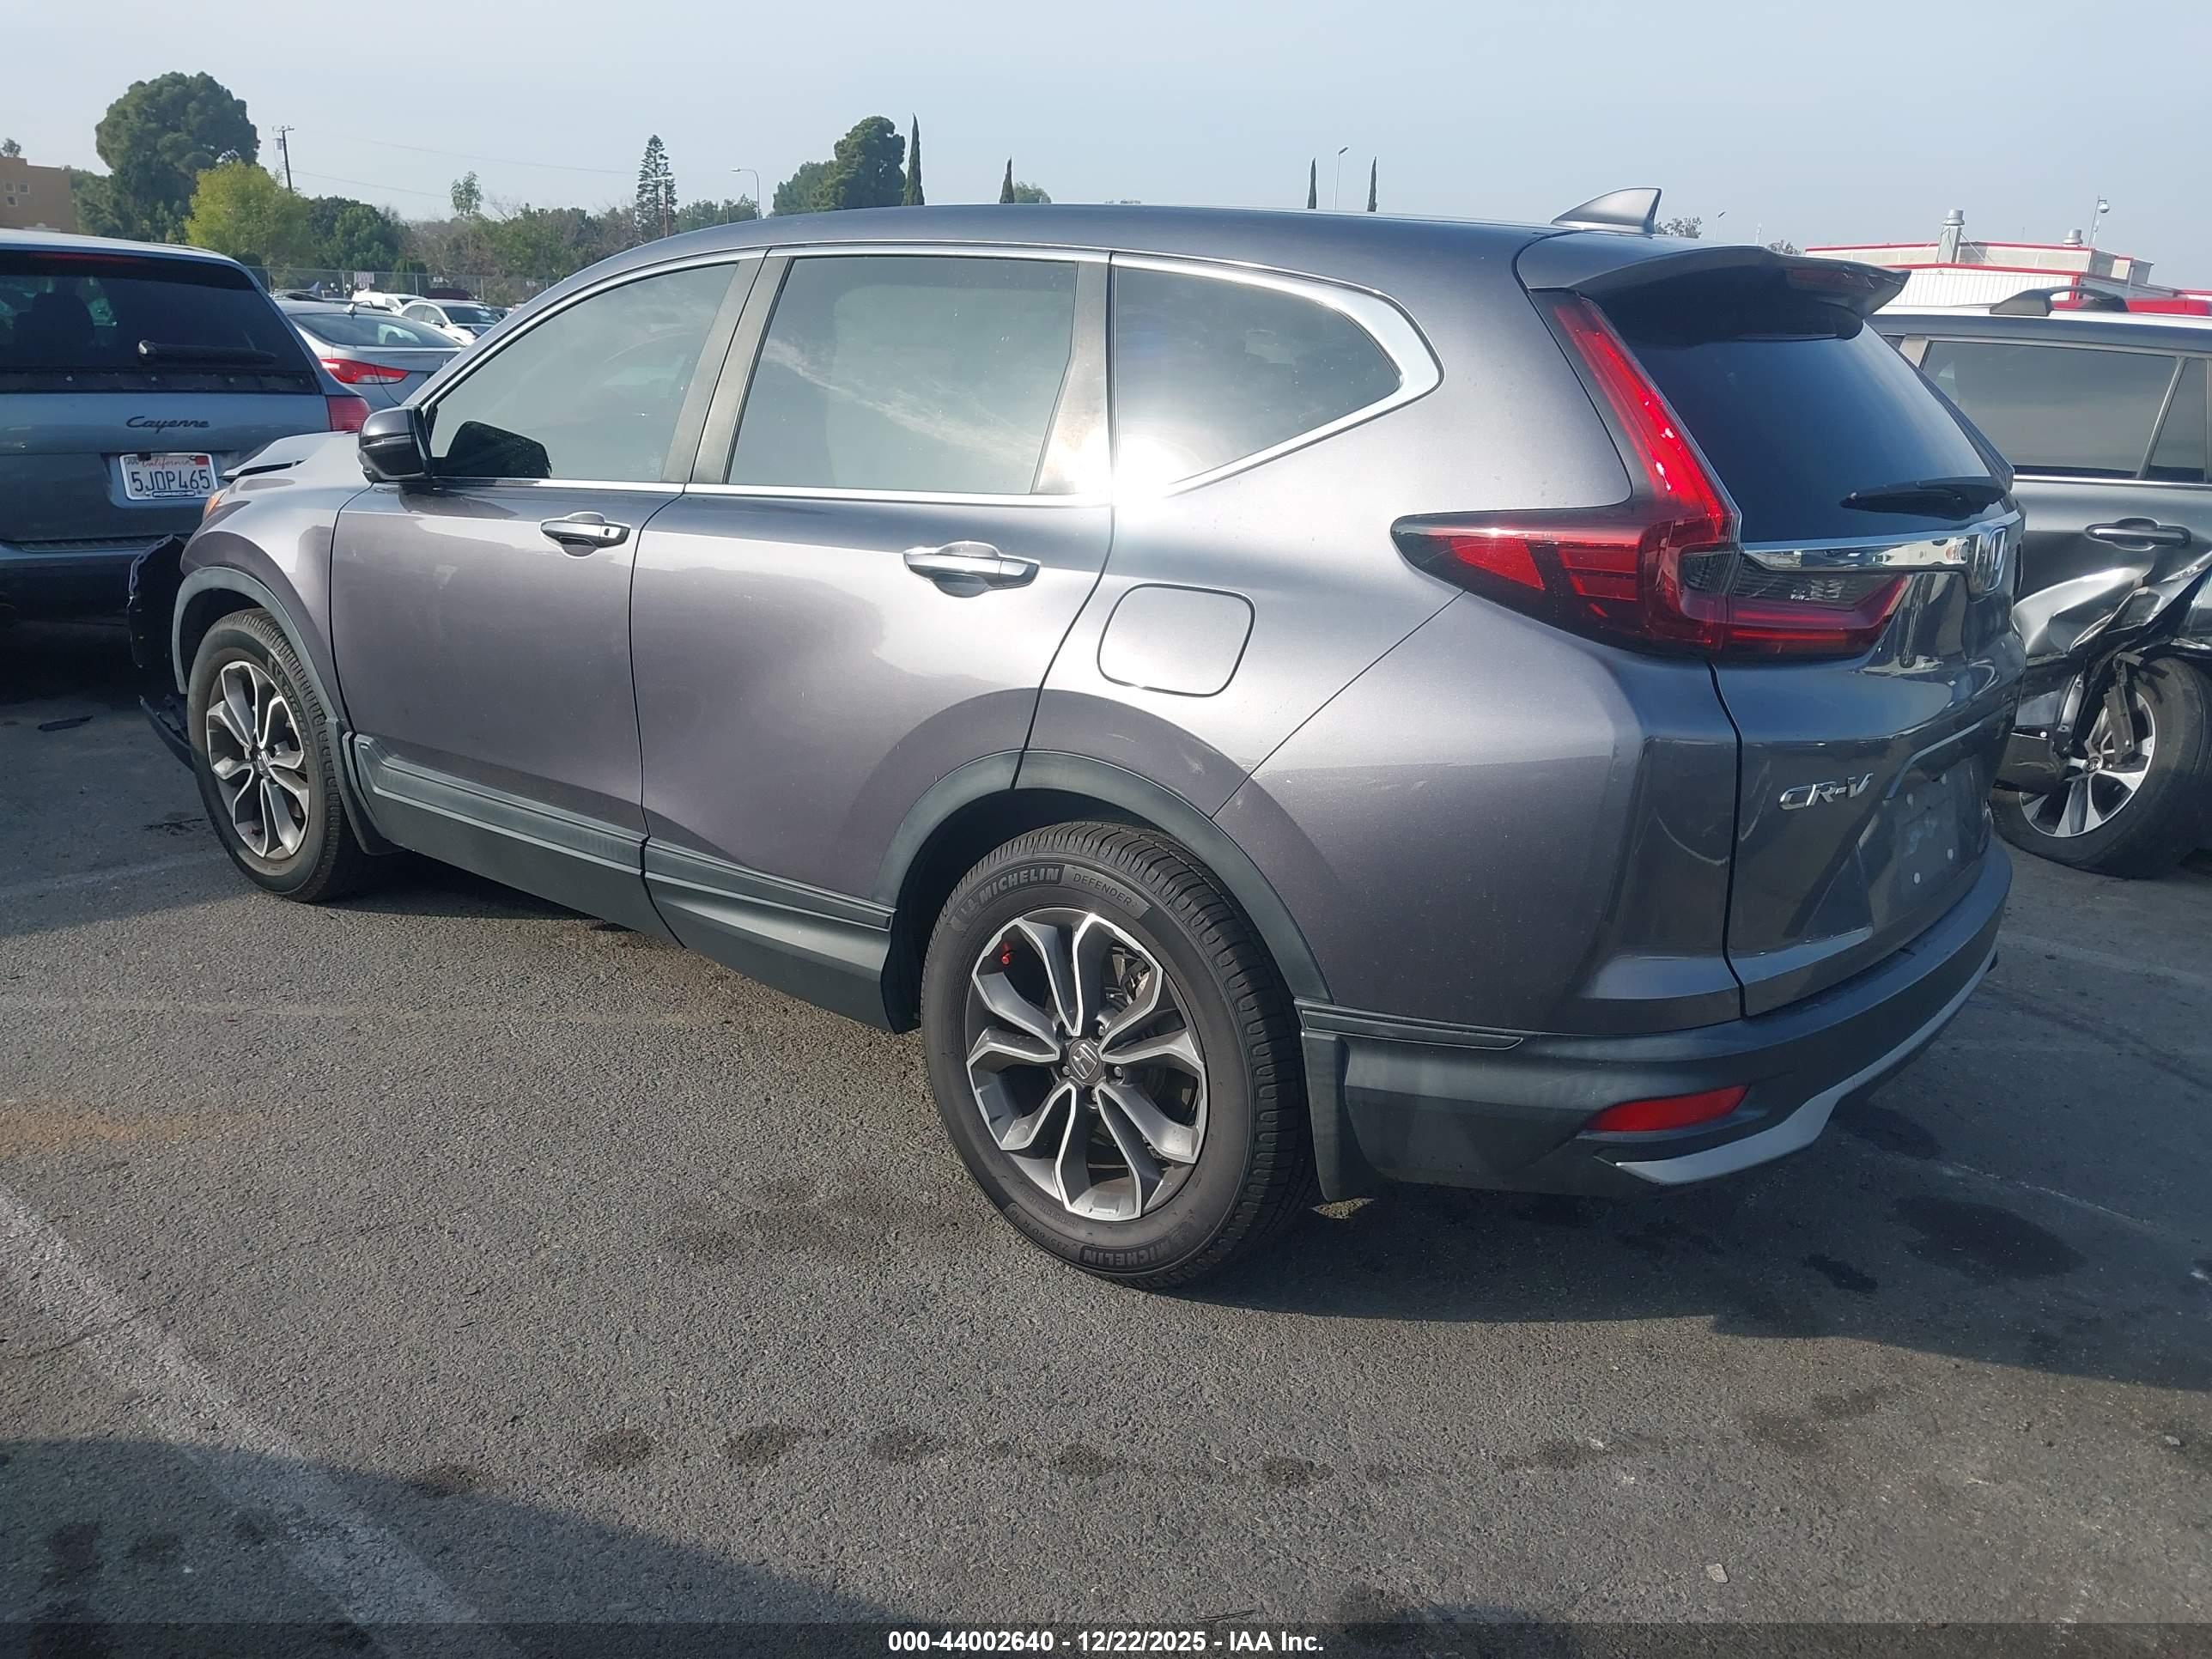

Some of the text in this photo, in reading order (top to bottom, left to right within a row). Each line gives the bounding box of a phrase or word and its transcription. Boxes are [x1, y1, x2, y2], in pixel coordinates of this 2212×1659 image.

[126, 416, 210, 434] Cayenne
[142, 457, 190, 470] California
[131, 469, 211, 492] 5JOP465
[1778, 772, 1875, 811] CR-V
[978, 867, 1060, 899] MICHELIN
[1083, 1242, 1170, 1266] MICHELIN
